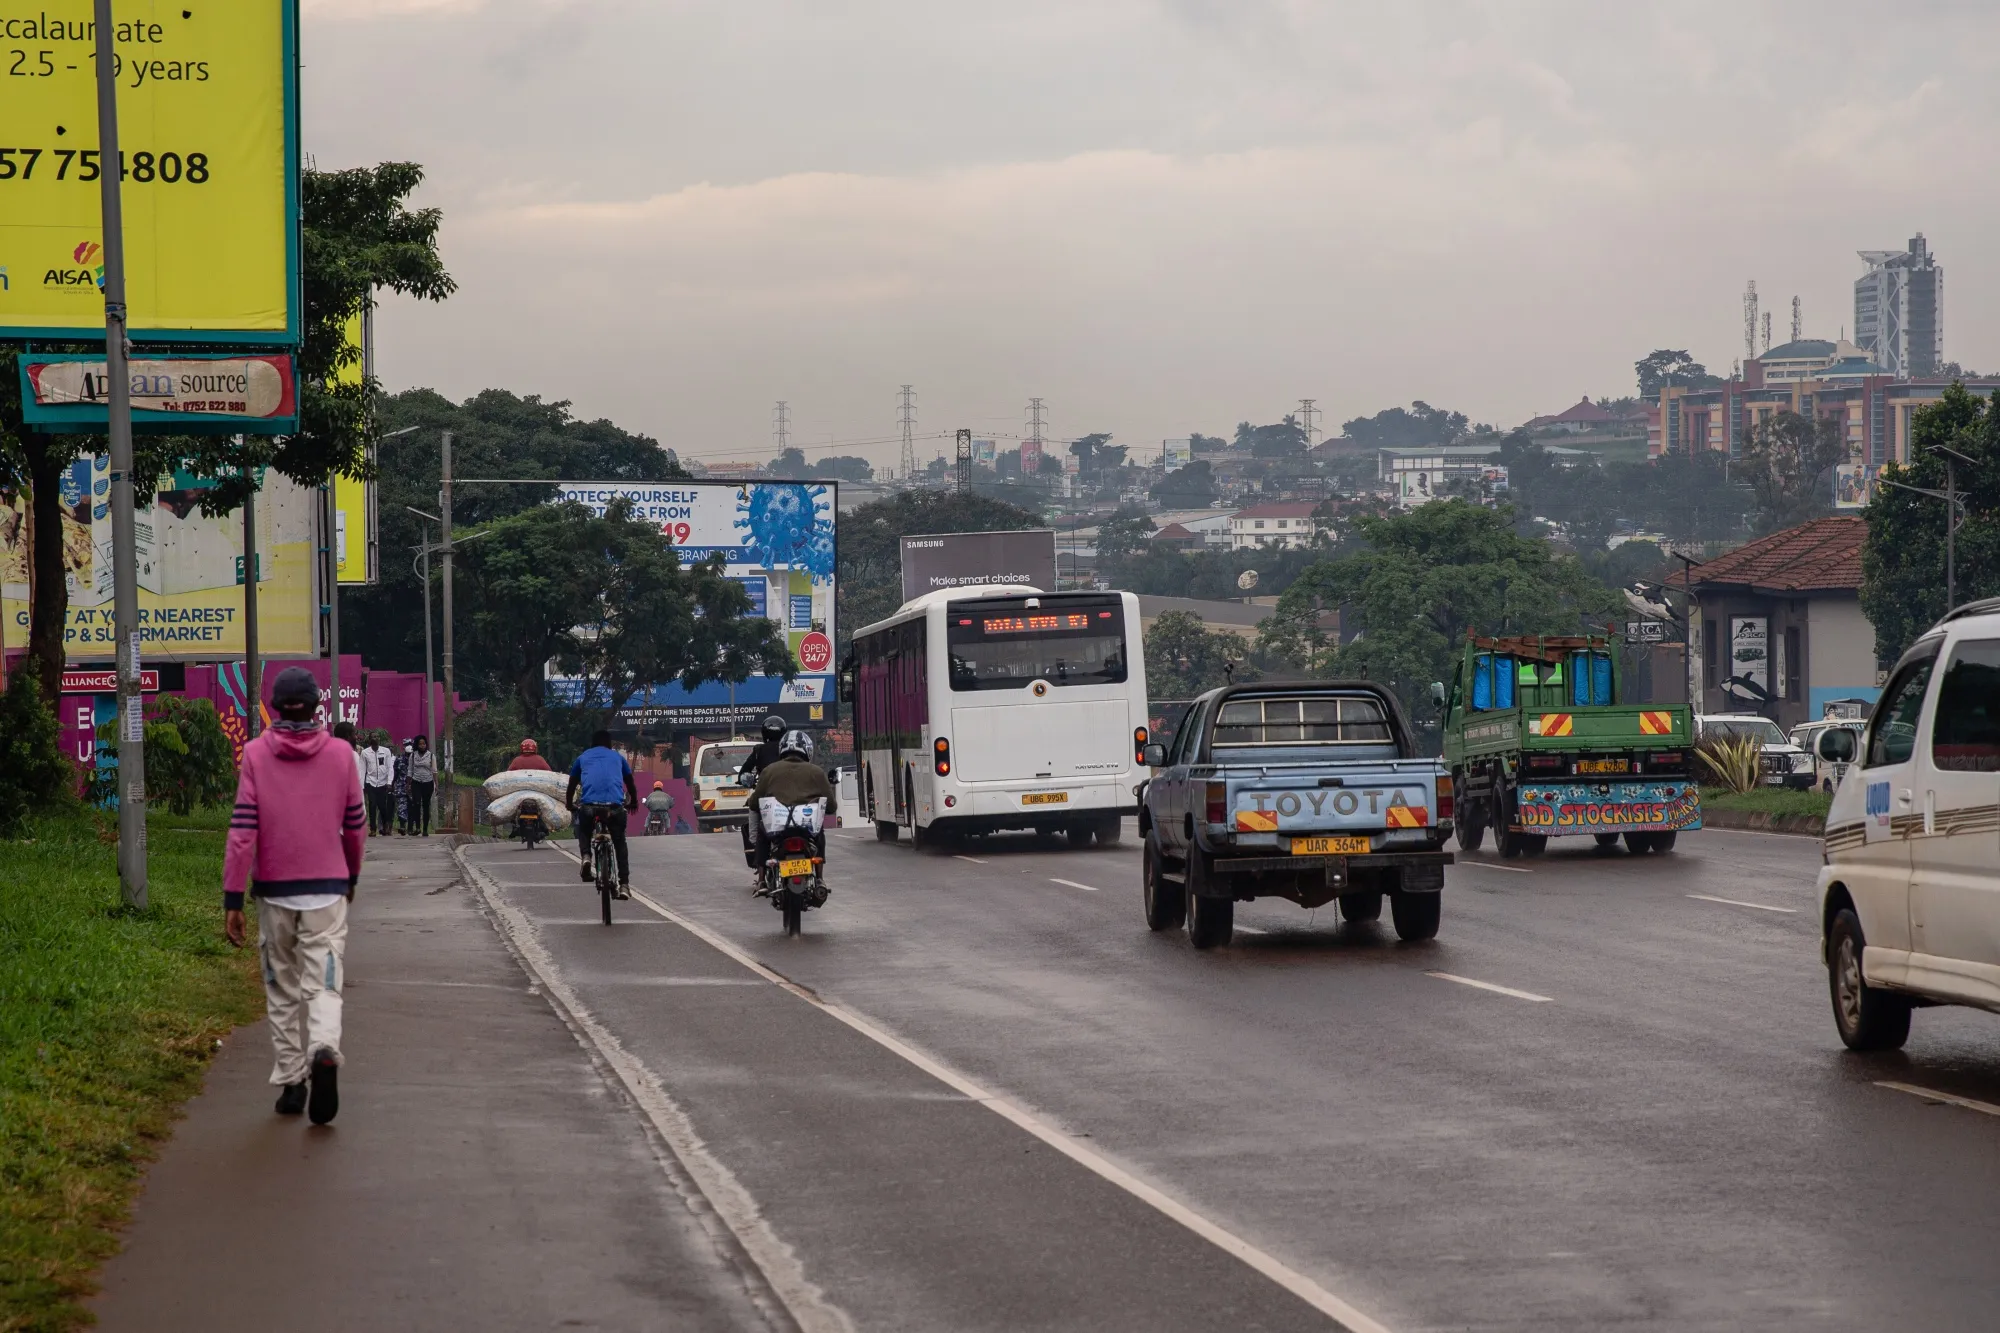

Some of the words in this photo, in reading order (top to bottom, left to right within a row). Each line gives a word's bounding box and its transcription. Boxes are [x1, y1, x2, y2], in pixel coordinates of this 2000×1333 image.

[9, 49, 54, 76] 2.5
[130, 59, 209, 88] years
[43, 269, 94, 285] AISA
[180, 374, 247, 394] source
[183, 401, 206, 412] 0752
[208, 401, 226, 411] 622
[228, 401, 246, 412] 980
[620, 490, 698, 503] YOURSELF
[650, 506, 691, 519] FROM
[906, 539, 944, 549] SAMSUNG
[930, 575, 957, 586] Make
[958, 574, 989, 584] smart
[991, 573, 1030, 584] choices
[75, 610, 96, 624] AT
[154, 608, 235, 623] NEAREST
[79, 628, 92, 641] &
[1629, 625, 1662, 635] ORCA
[803, 643, 828, 653] OPEN
[805, 653, 827, 662] 24/7
[663, 708, 678, 716] HIRE
[679, 707, 693, 716] THIS
[694, 707, 714, 716] SPACE
[715, 706, 739, 715] PLEAE
[740, 706, 768, 714] CONTACT
[1030, 794, 1044, 803] UBG
[1047, 793, 1064, 802] 995X
[1250, 789, 1410, 817] TOYOTA
[1558, 803, 1666, 827] STOCKISTS
[1306, 838, 1328, 852] UAR
[1335, 838, 1365, 852] 364M
